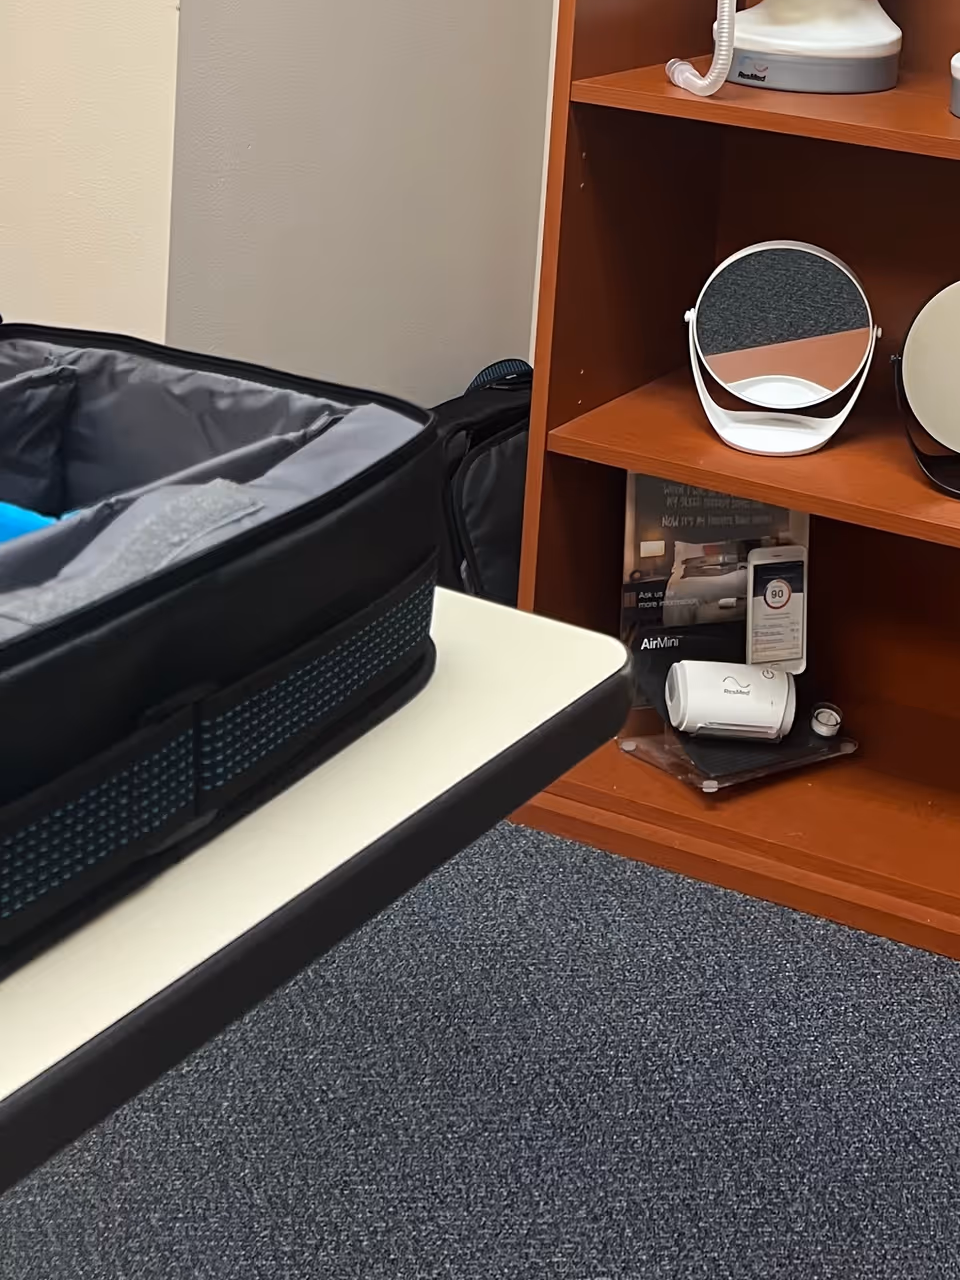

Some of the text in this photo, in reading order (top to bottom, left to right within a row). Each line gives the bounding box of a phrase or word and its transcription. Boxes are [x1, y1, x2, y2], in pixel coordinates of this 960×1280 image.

[737, 71, 767, 82] ResMed
[638, 591, 652, 599] Ask
[771, 589, 784, 599] 90
[641, 636, 679, 650] AirMini
